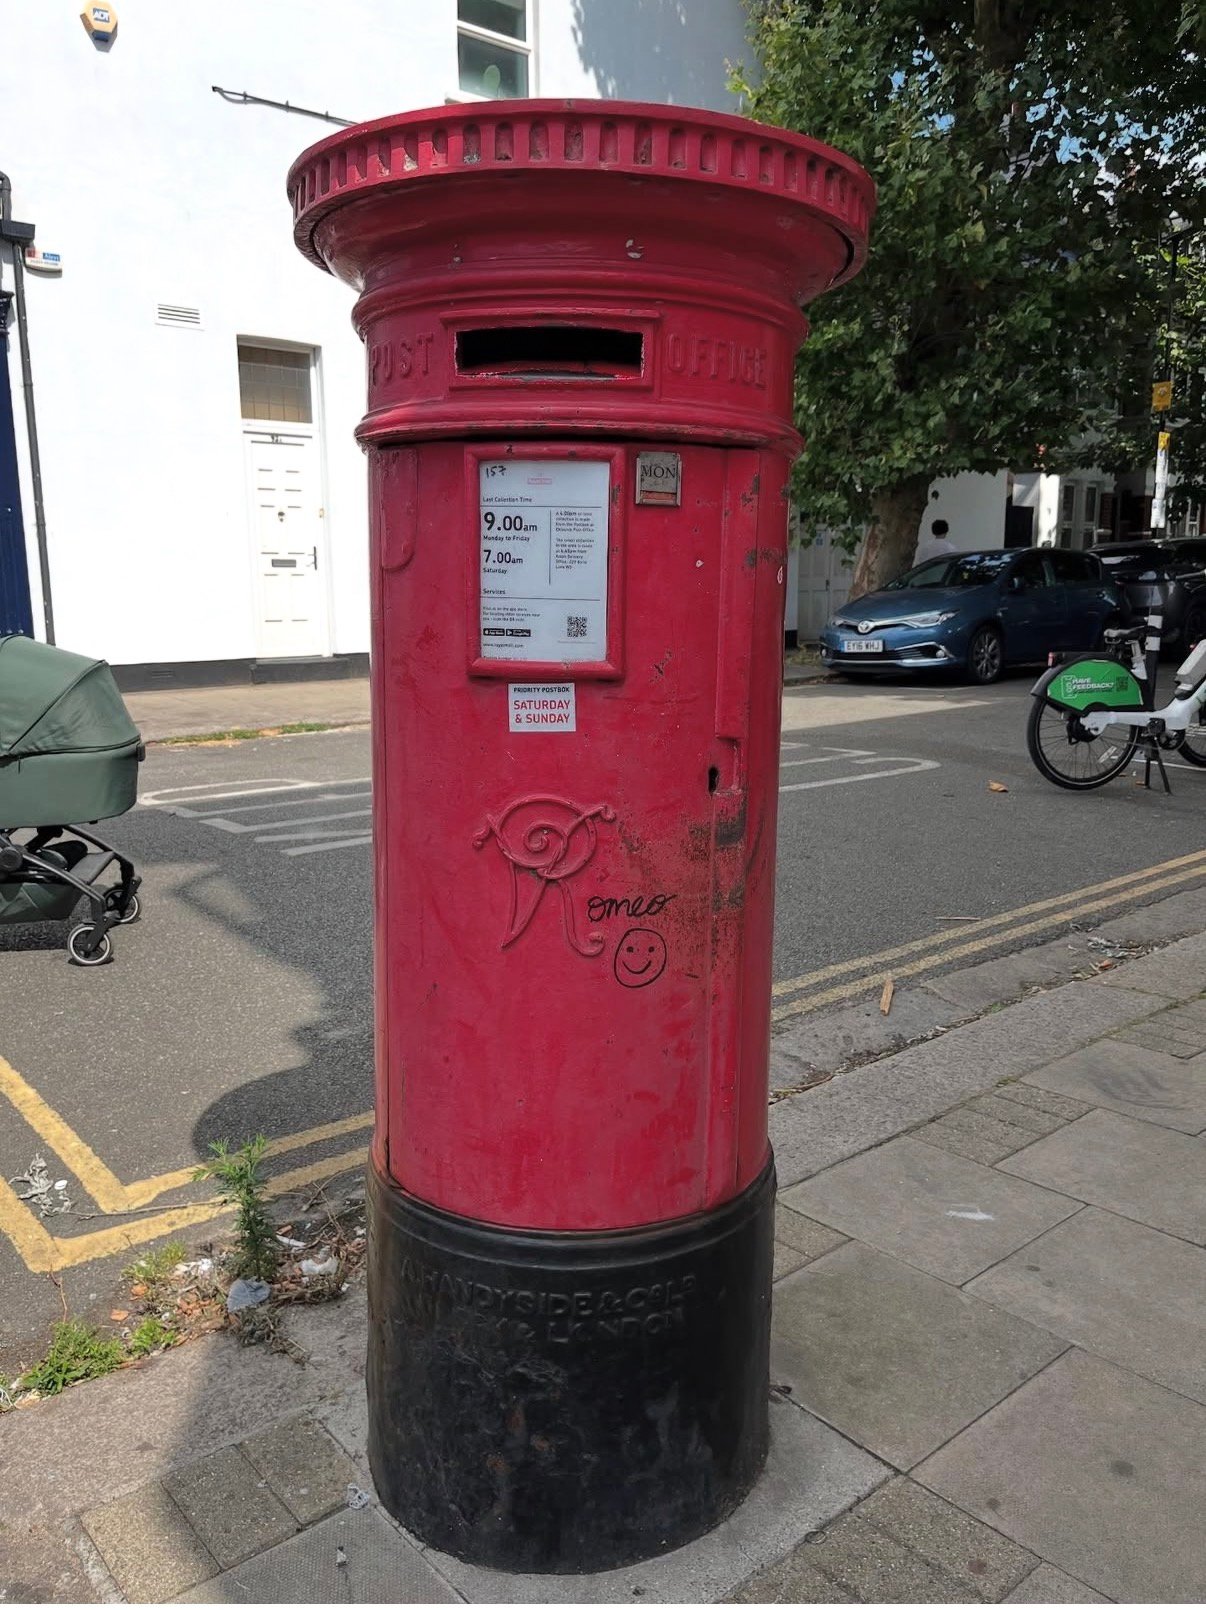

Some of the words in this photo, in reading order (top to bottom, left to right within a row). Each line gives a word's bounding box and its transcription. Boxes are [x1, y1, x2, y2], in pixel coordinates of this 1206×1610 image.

[371, 333, 434, 386] POST
[667, 333, 767, 391] OFFICE
[641, 464, 676, 479] MON
[484, 512, 537, 531] 9.00am
[483, 550, 523, 564] 7.00am
[513, 700, 571, 710] SATURDAY
[515, 714, 522, 723] &
[526, 714, 570, 723] SUNDAY
